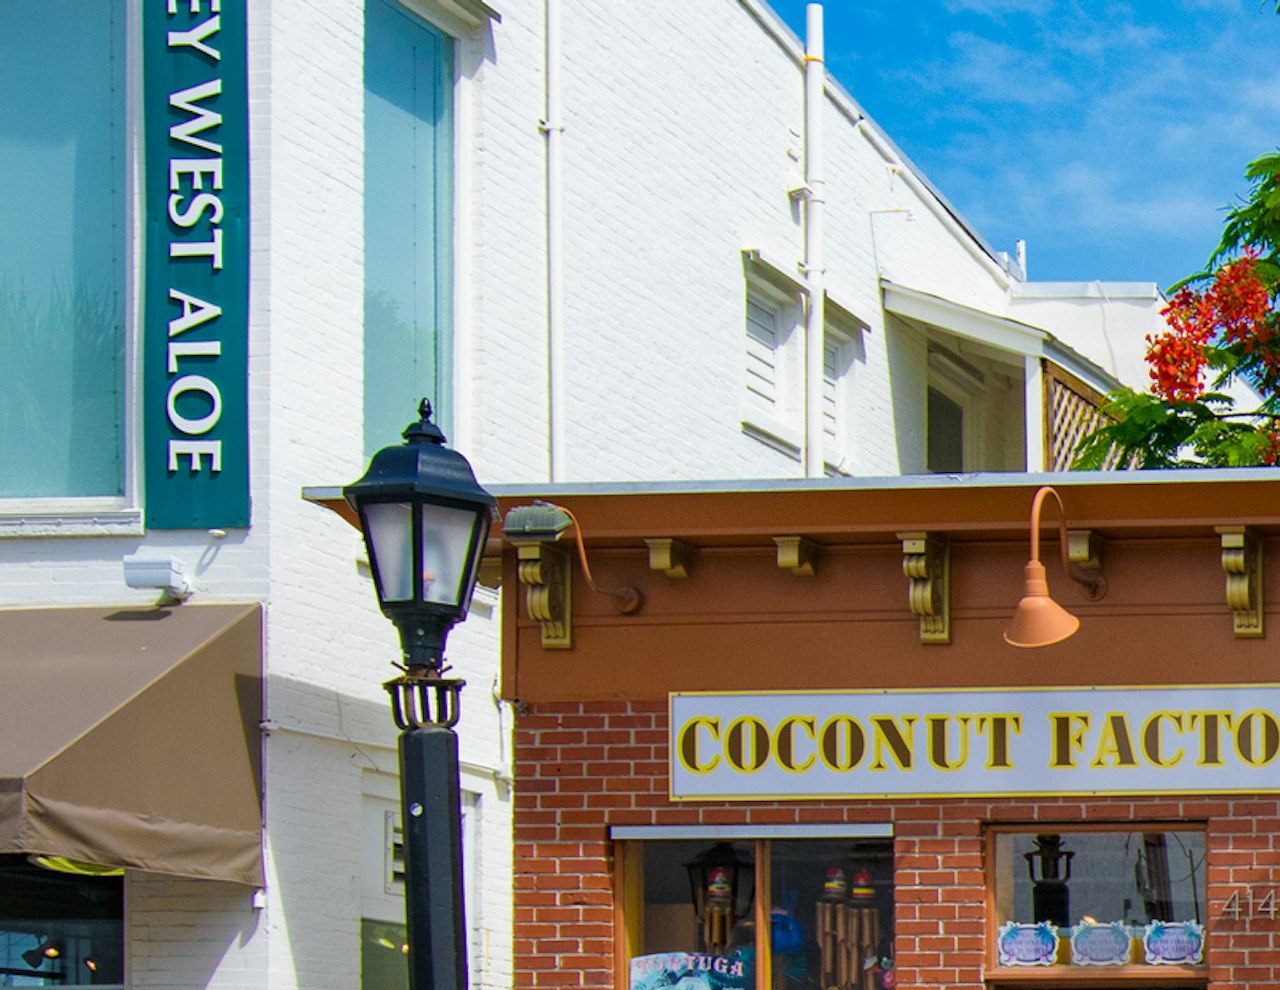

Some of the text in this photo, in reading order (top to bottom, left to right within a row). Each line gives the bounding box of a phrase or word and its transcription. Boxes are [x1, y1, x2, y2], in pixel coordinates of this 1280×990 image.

[167, 78, 223, 270] WEST
[166, 289, 222, 473] ALOE
[677, 713, 1023, 773] COCONUT
[1221, 889, 1279, 921] 414
[635, 955, 744, 977] TORTUGA
